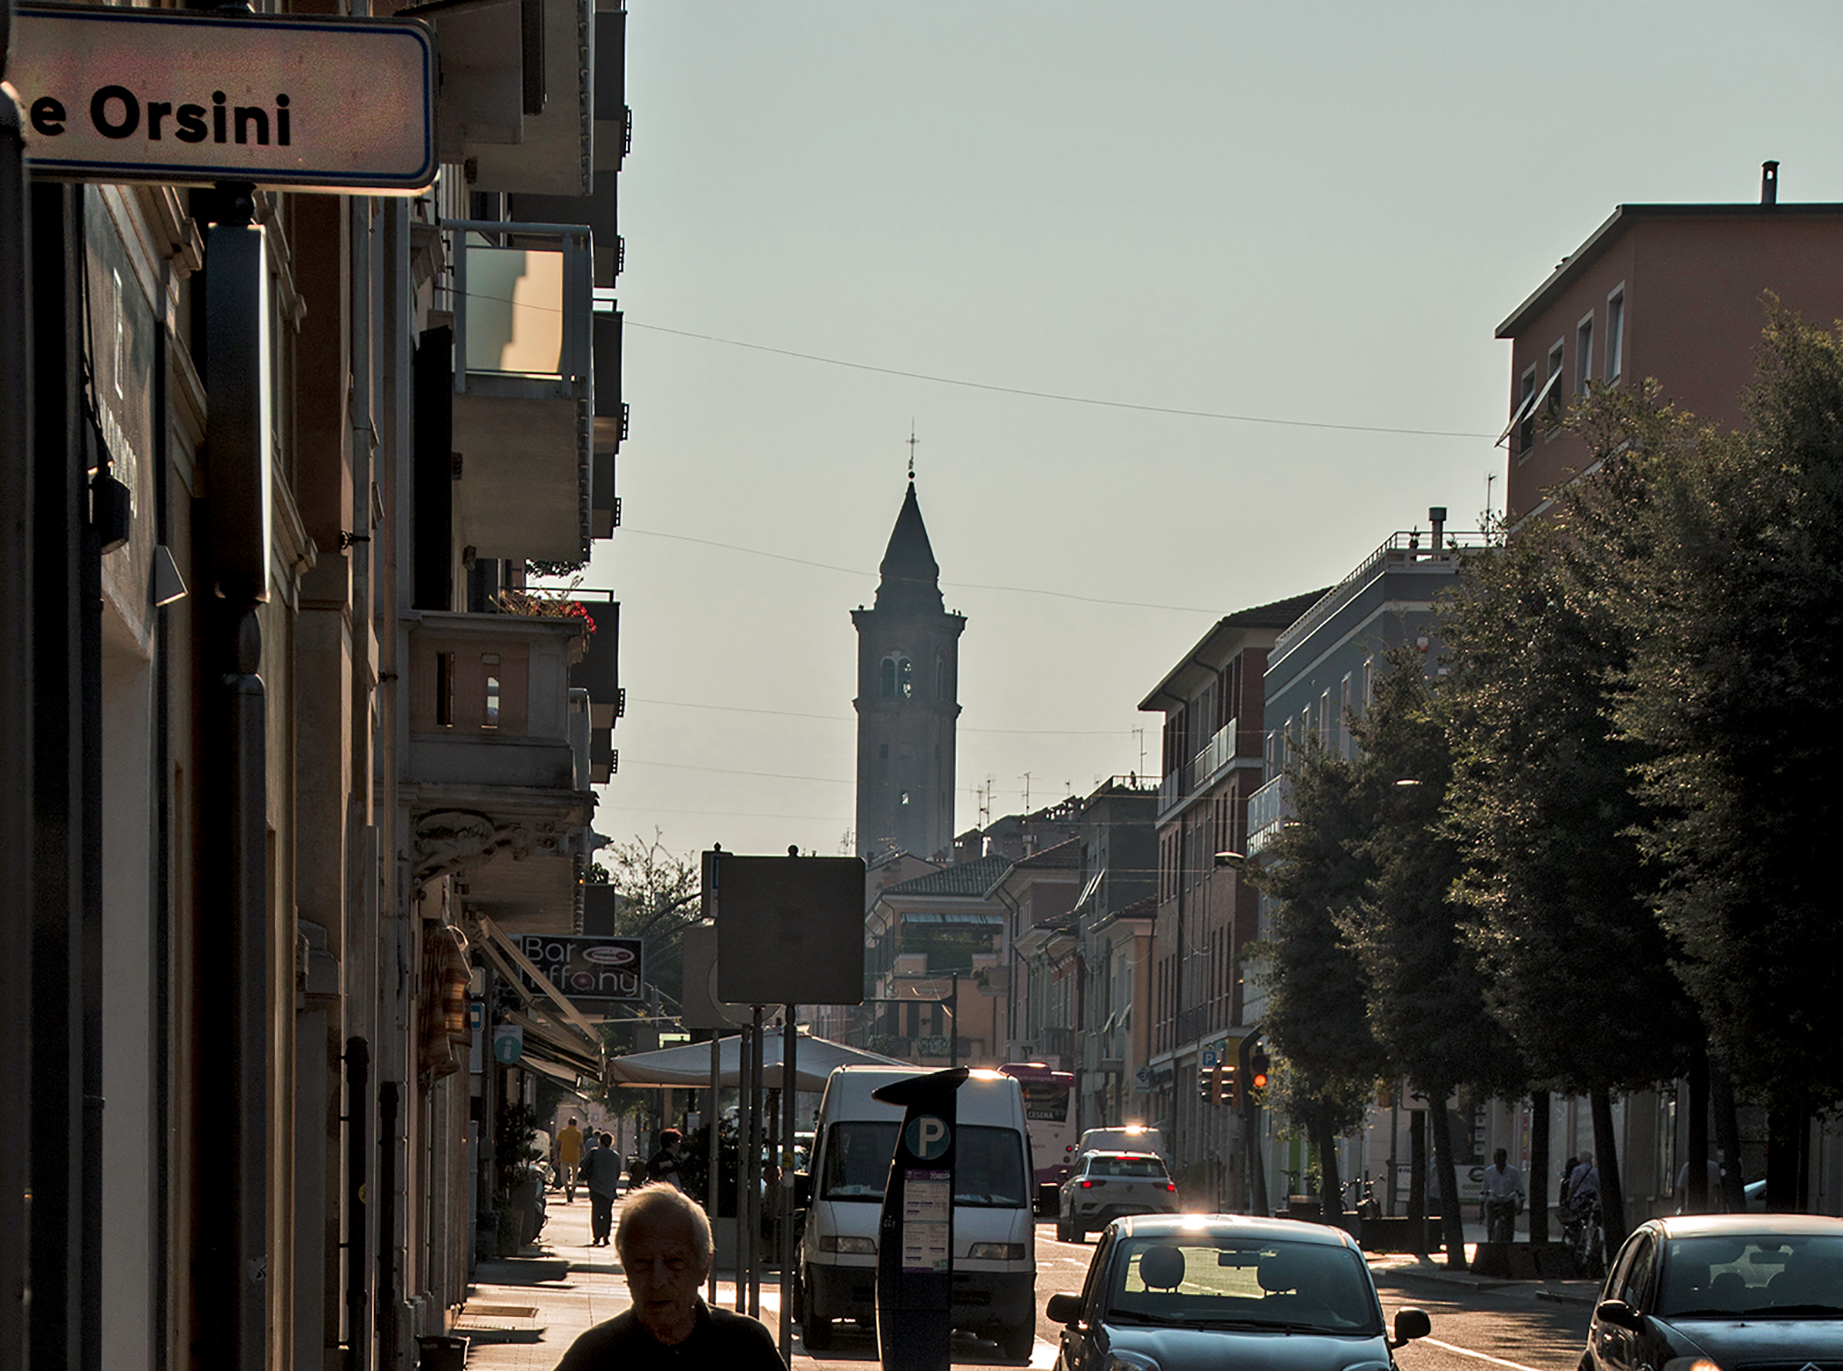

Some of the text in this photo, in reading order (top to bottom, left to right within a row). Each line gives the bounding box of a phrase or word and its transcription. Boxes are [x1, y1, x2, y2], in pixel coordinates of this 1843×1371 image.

[30, 85, 290, 146] e Orsini
[525, 937, 576, 963] Bar
[919, 1117, 945, 1157] P
